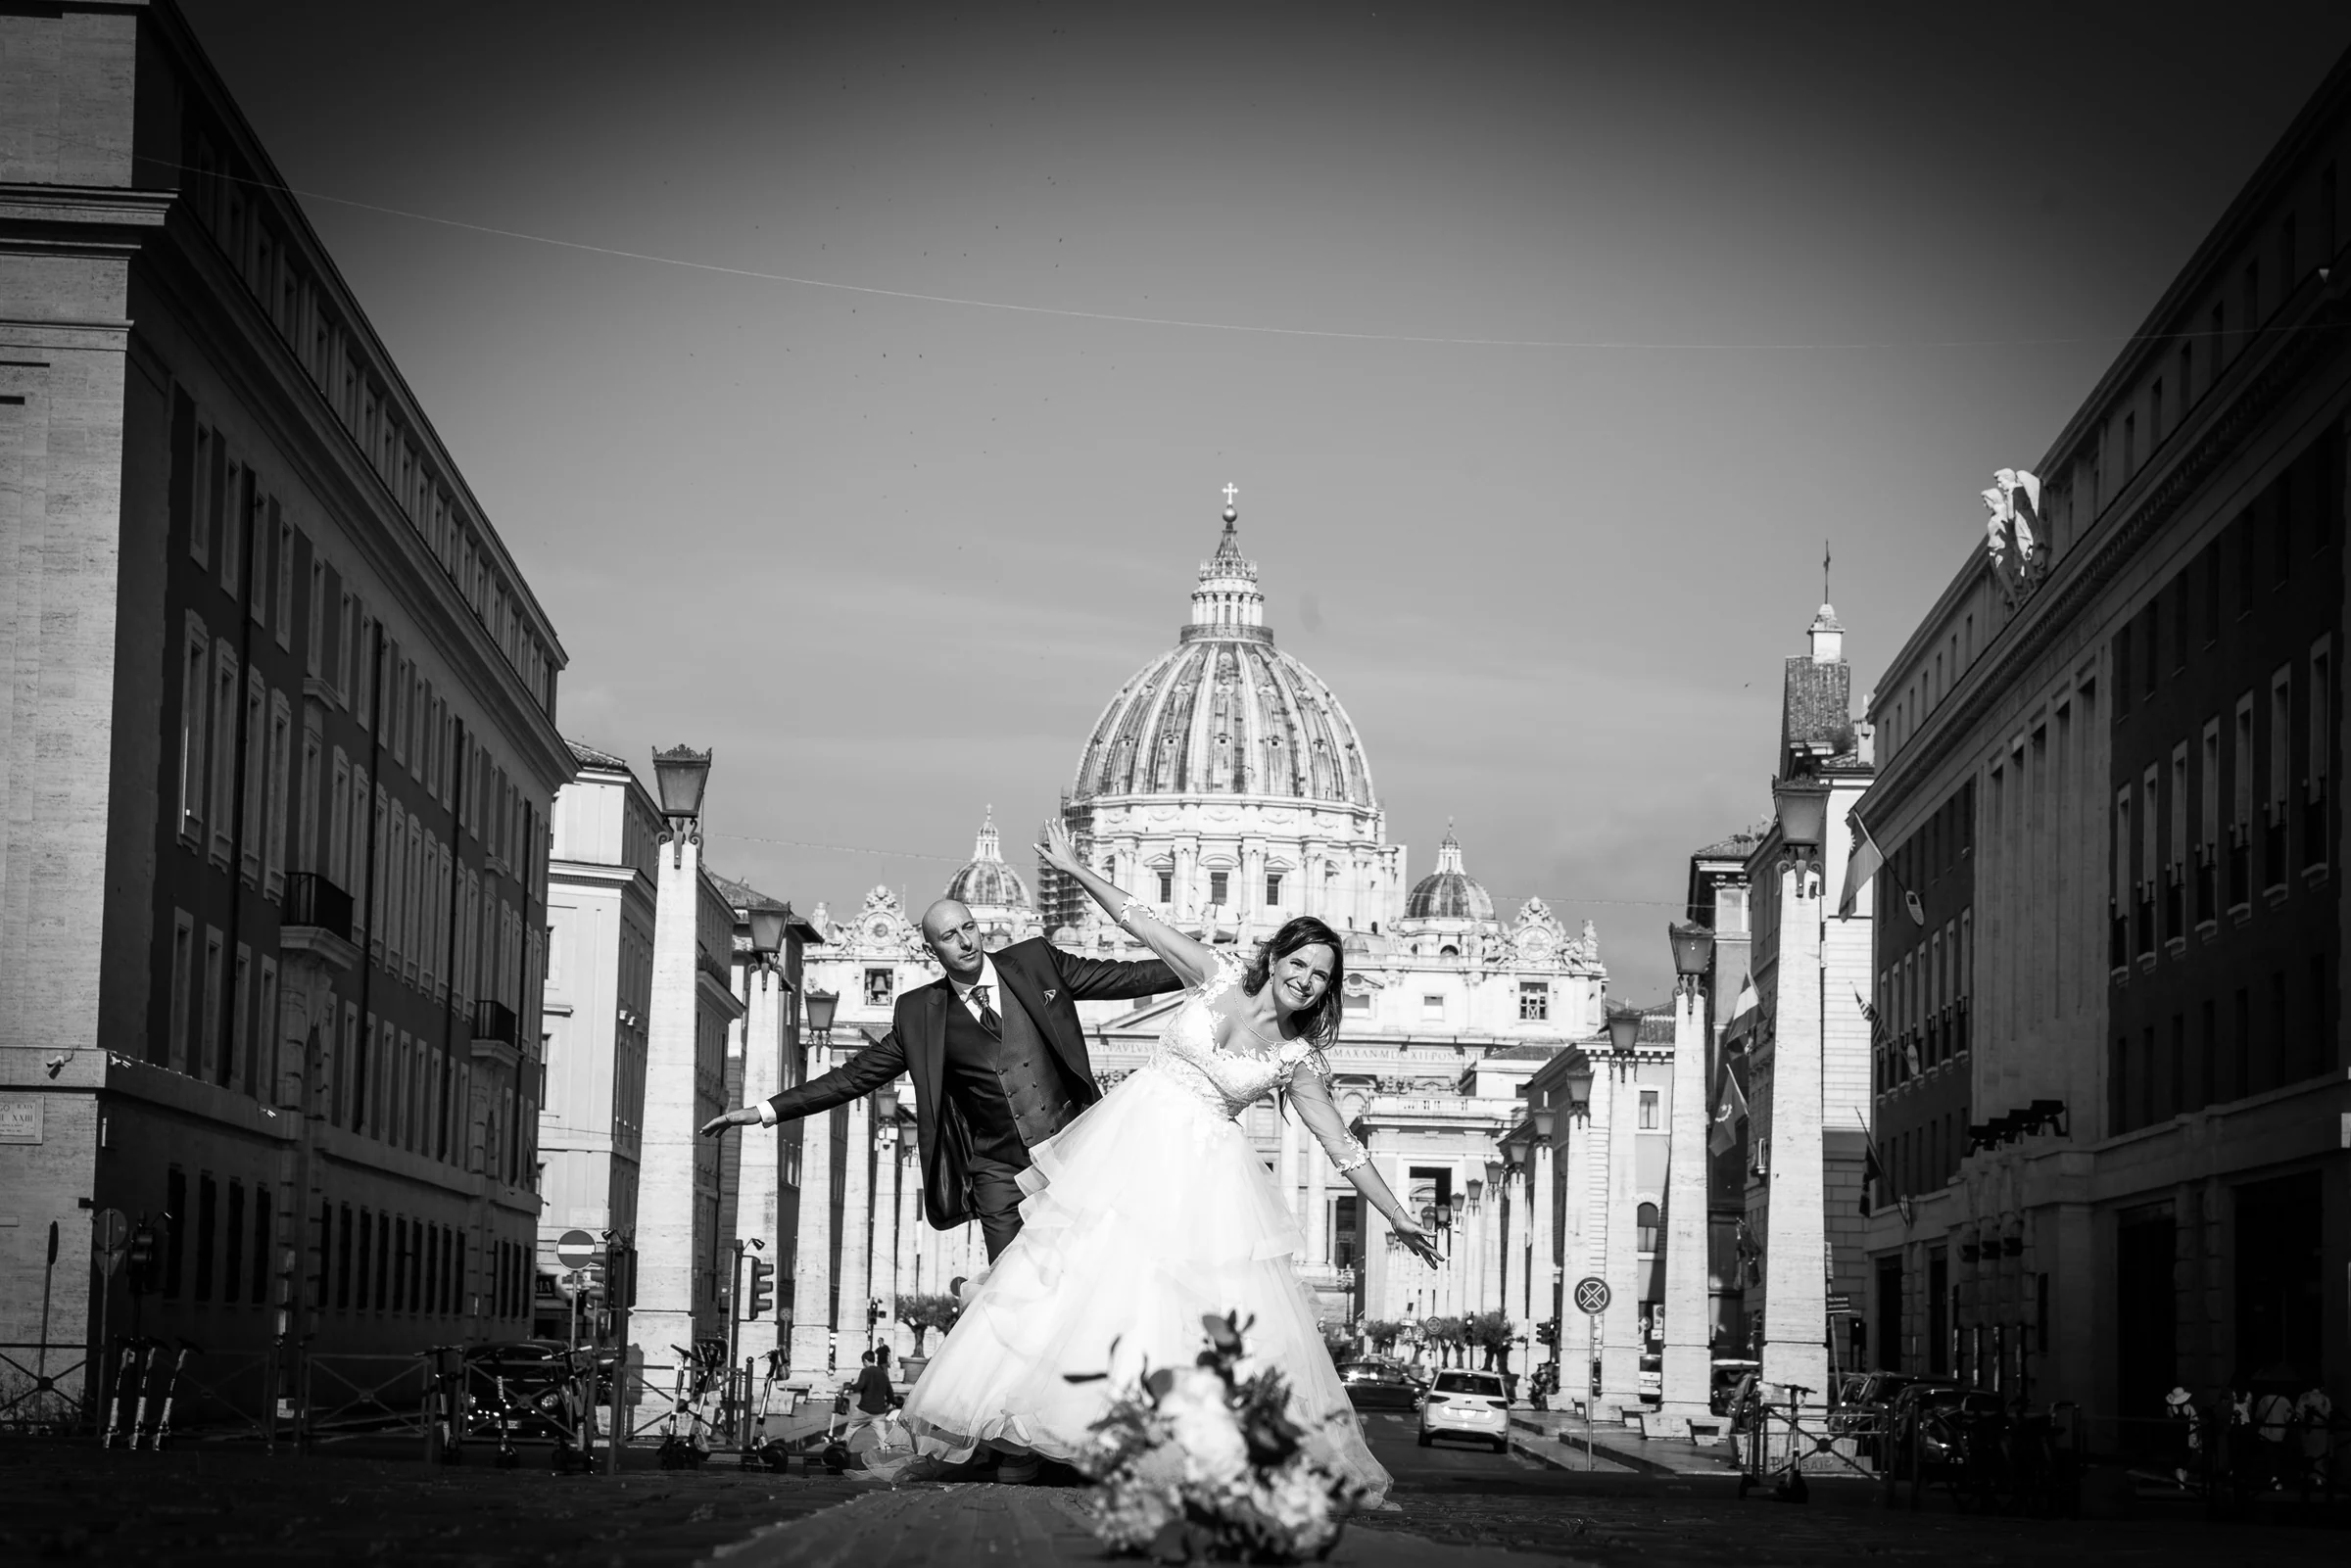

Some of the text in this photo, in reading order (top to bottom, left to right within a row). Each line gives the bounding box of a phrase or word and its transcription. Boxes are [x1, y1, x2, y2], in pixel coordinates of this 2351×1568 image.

[1333, 1048, 1360, 1058] MAX
[1430, 1051, 1462, 1061] PONT
[12, 1114, 33, 1122] XXIII
